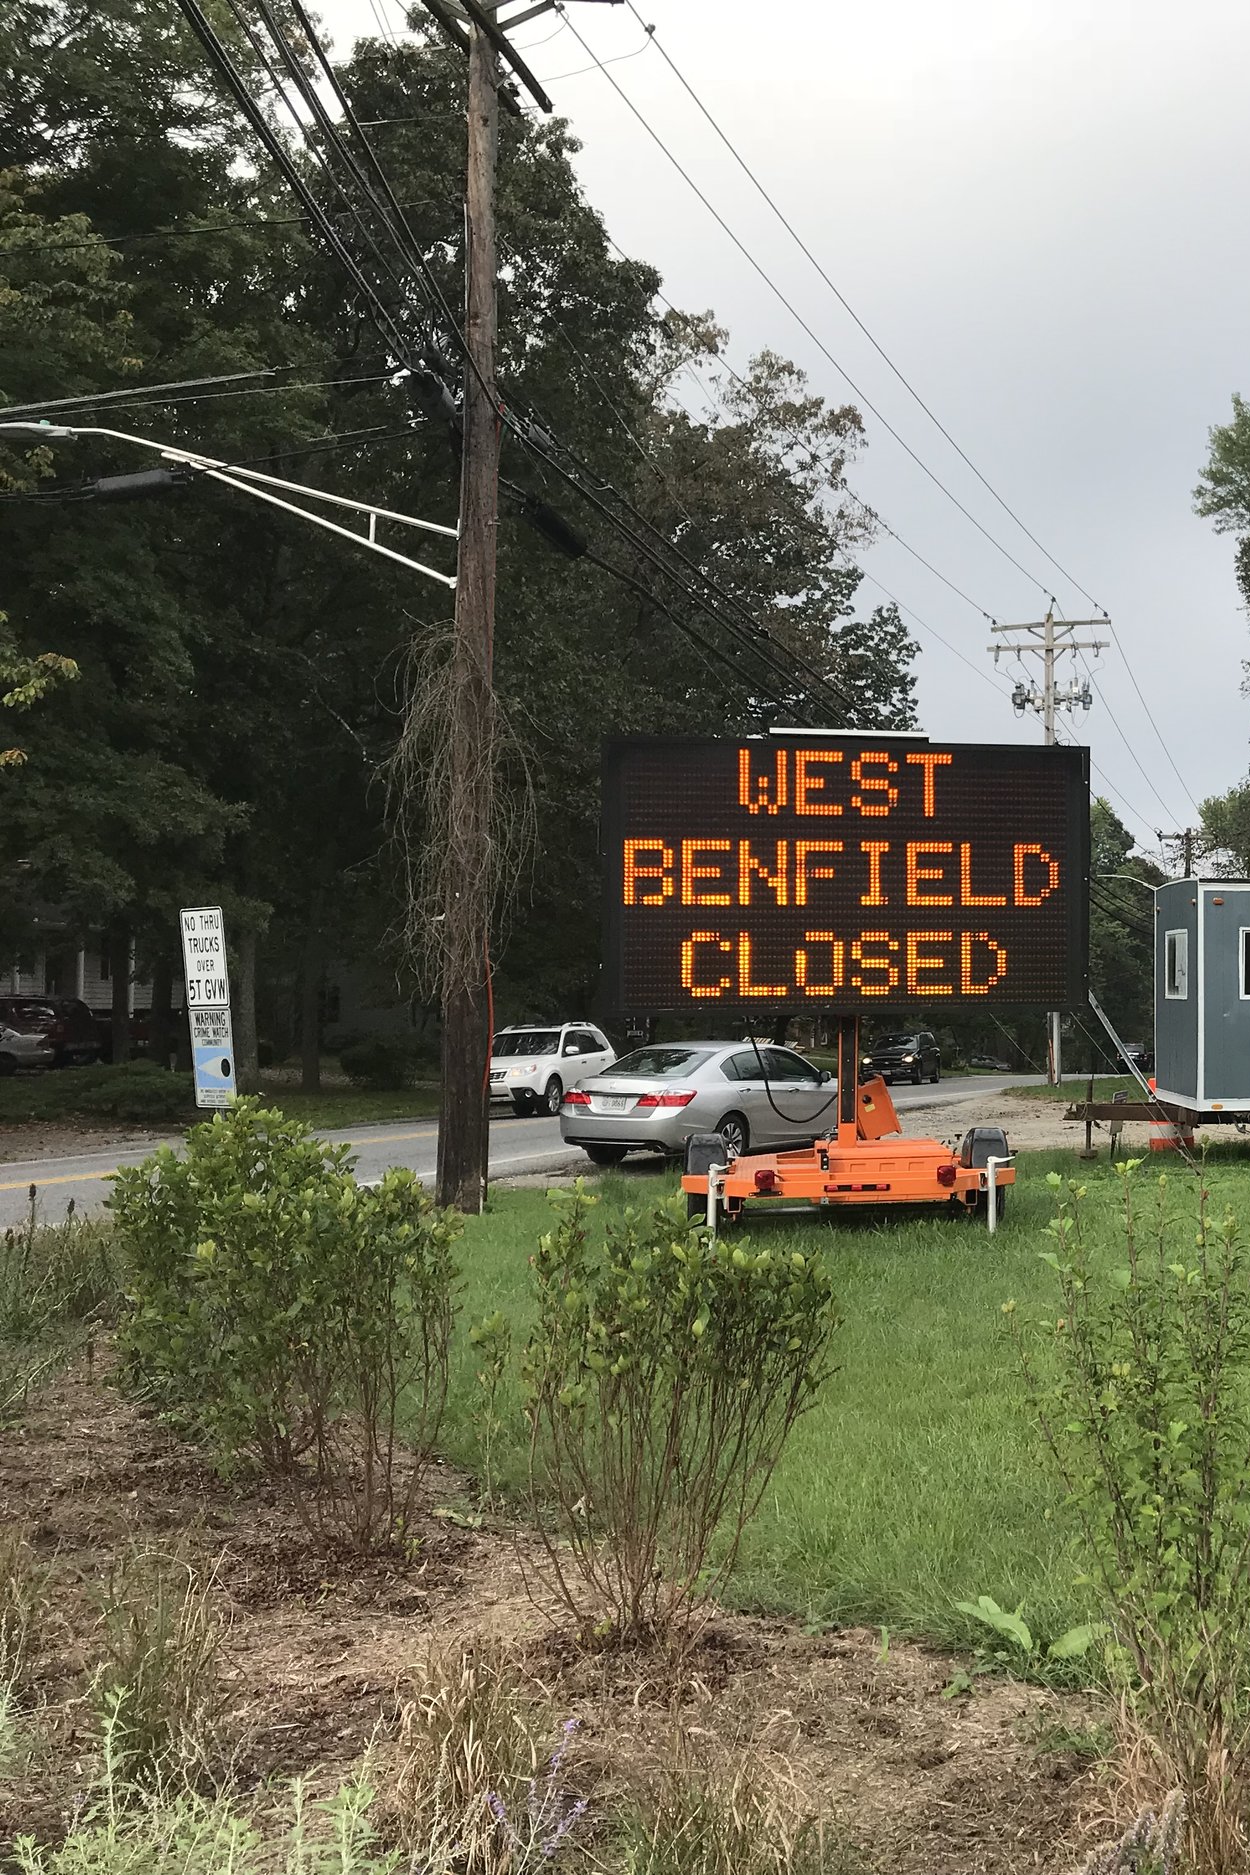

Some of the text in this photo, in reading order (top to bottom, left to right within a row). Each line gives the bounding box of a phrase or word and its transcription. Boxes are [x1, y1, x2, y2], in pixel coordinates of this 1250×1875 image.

[739, 749, 953, 818] WEST
[623, 839, 1060, 907] BENFIELD
[184, 914, 219, 932] NO THRU
[188, 936, 220, 954] TRUCKS
[196, 959, 215, 972] OVER
[681, 931, 1007, 997] CLOSED
[189, 978, 226, 1001] 5T GVW
[194, 1011, 226, 1027] WARNING
[193, 1026, 229, 1038] CRIME WATCH
